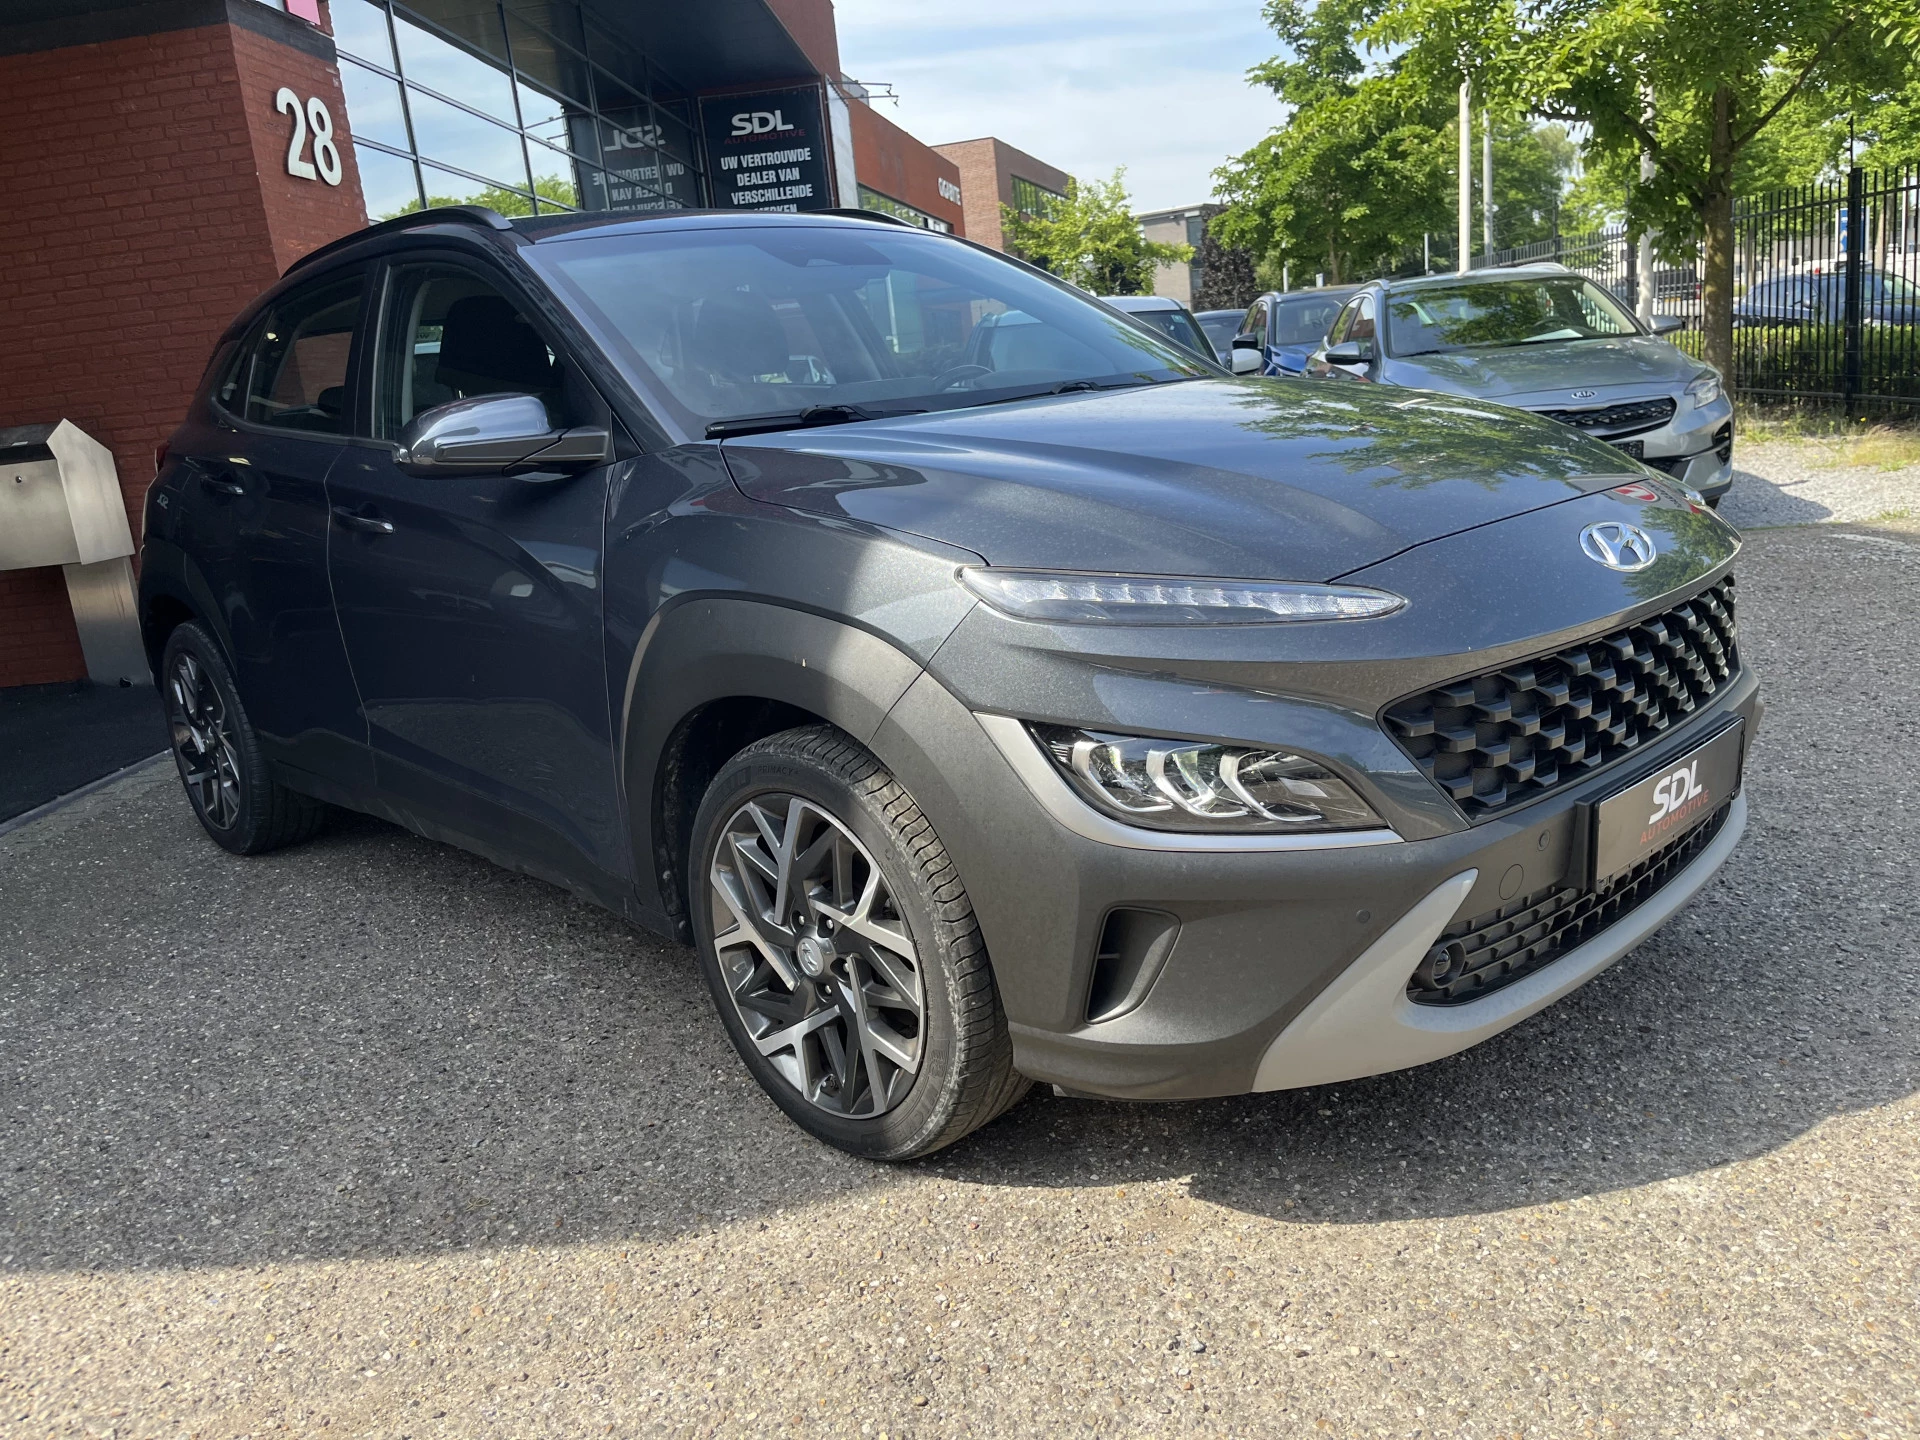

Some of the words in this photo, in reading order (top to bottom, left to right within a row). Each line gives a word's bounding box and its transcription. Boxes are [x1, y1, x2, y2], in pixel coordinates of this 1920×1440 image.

[731, 109, 794, 136] SDL
[276, 87, 342, 186] 28
[724, 128, 806, 145] AUTOMOTIVE
[721, 156, 738, 170] UW
[740, 147, 811, 168] VERTROUWDE
[737, 170, 776, 186] DEALER
[778, 167, 800, 181] VAN
[731, 184, 813, 205] VERSCHILLENDE
[757, 764, 794, 776] PRIMACY
[1648, 760, 1702, 825] SDL
[1640, 789, 1709, 845] AUTOMOTIVE
